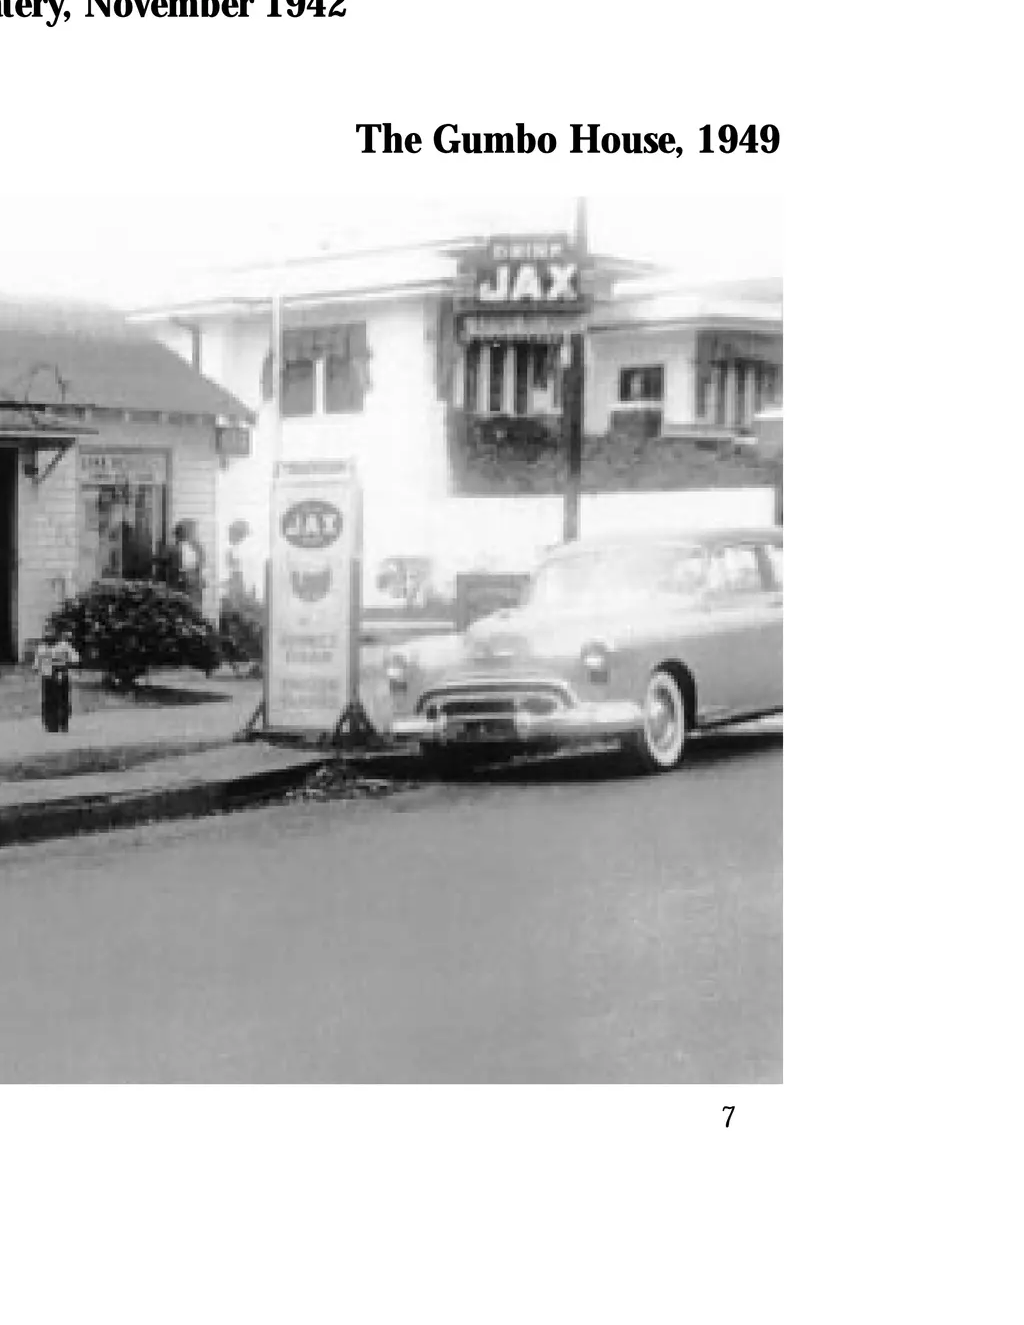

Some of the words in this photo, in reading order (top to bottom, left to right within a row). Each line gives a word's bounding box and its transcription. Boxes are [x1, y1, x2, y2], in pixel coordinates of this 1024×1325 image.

[356, 123, 422, 153] The
[434, 123, 556, 153] Gumbo
[570, 124, 683, 158] House,
[699, 124, 780, 153] 1949
[480, 263, 576, 301] JAX
[723, 1106, 735, 1128] 7
